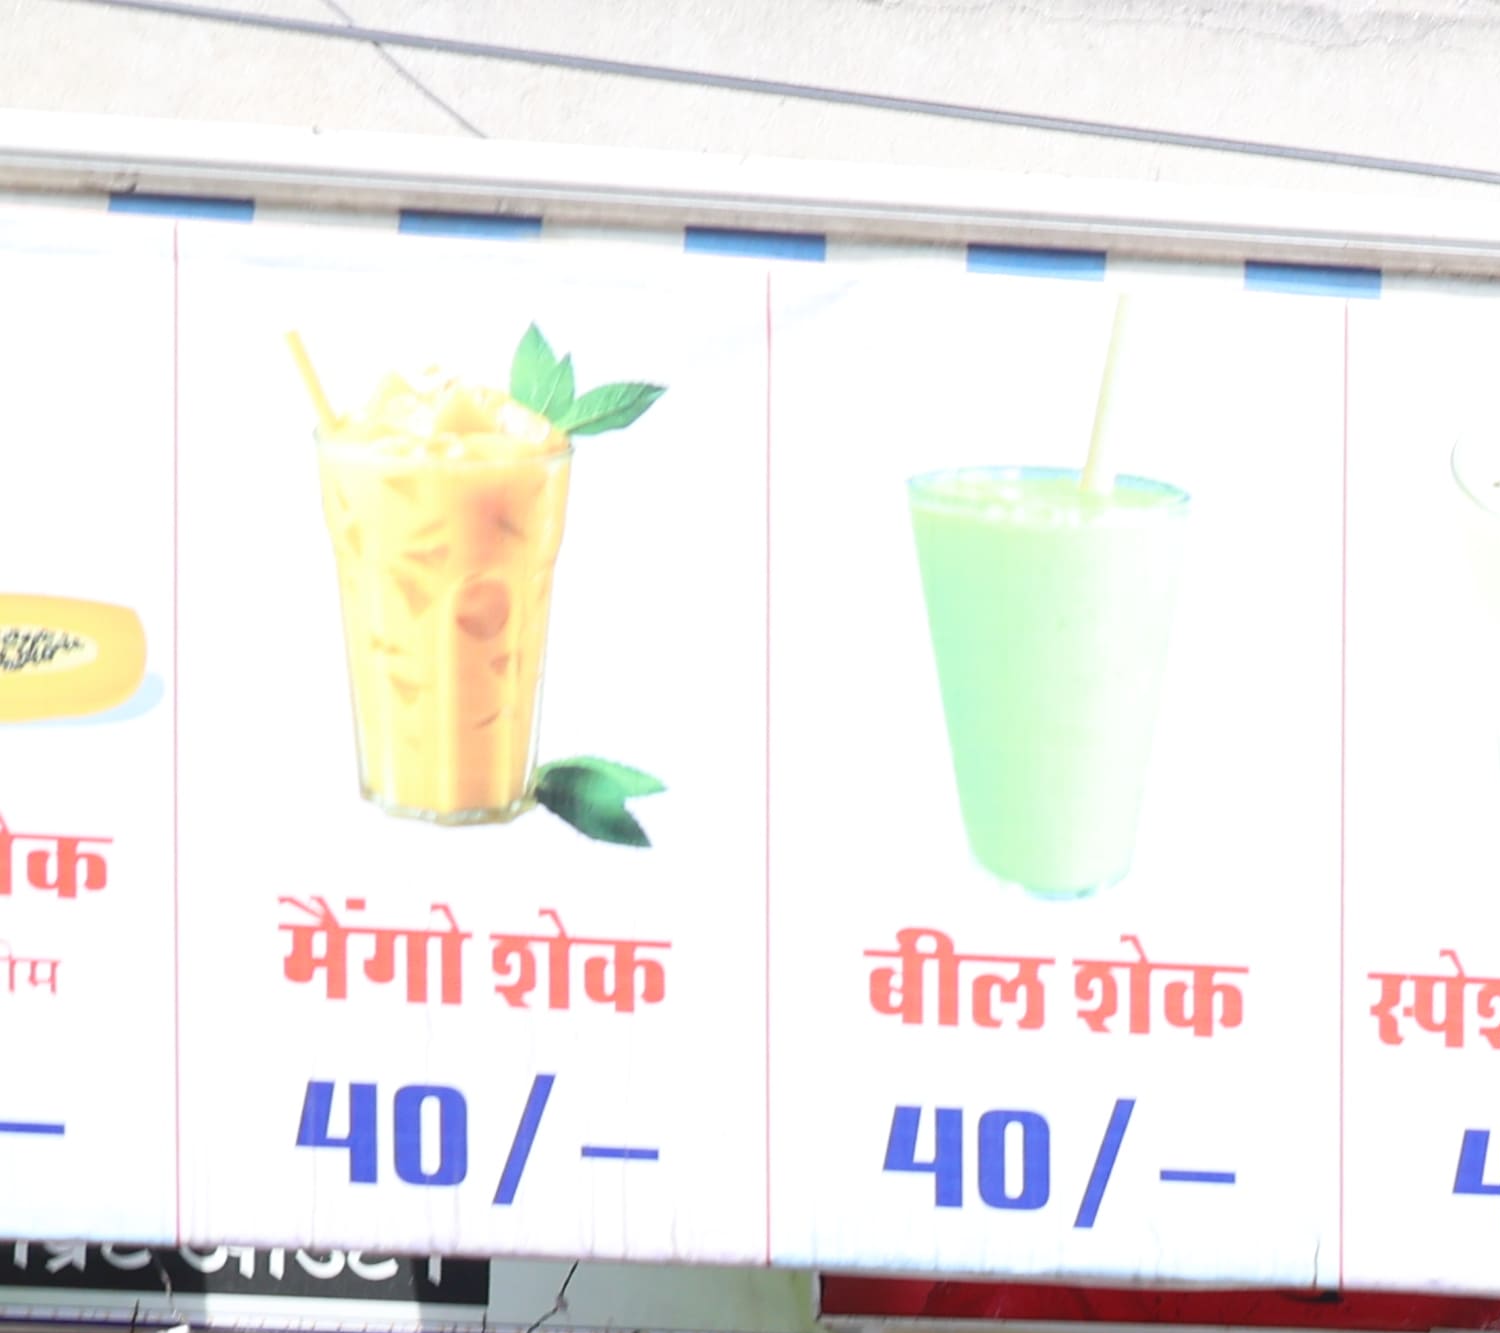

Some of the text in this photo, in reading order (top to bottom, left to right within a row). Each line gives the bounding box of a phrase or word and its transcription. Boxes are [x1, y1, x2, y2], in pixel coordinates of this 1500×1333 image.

[277, 895, 673, 1014] मैंगो शेक
[863, 926, 1250, 1039] बील शेक
